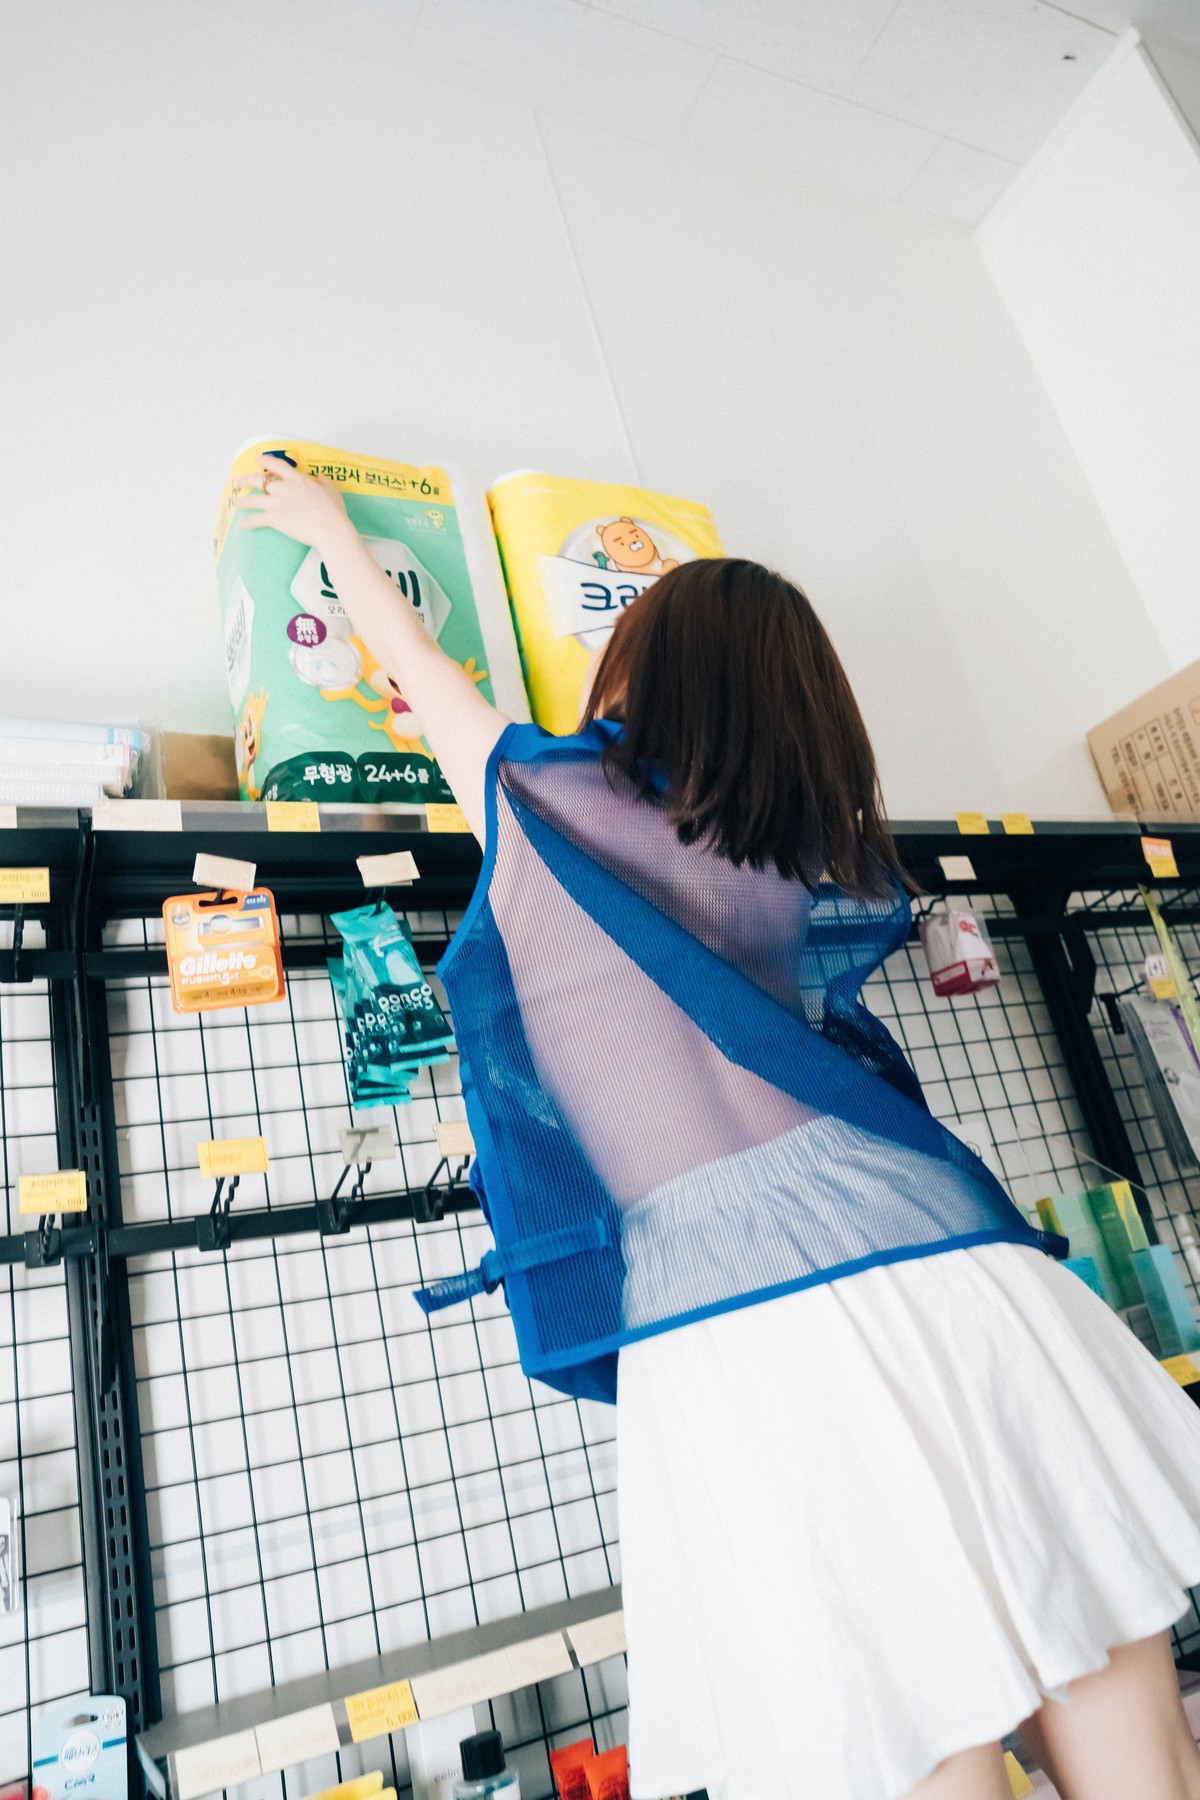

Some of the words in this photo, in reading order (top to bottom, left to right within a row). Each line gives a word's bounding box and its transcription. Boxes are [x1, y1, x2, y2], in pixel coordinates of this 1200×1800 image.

[307, 463, 361, 484] 고객감사
[302, 762, 353, 786] 무형광
[363, 763, 430, 785] 24+6롤
[179, 951, 257, 977] Gillette
[377, 983, 433, 1011] DORCO
